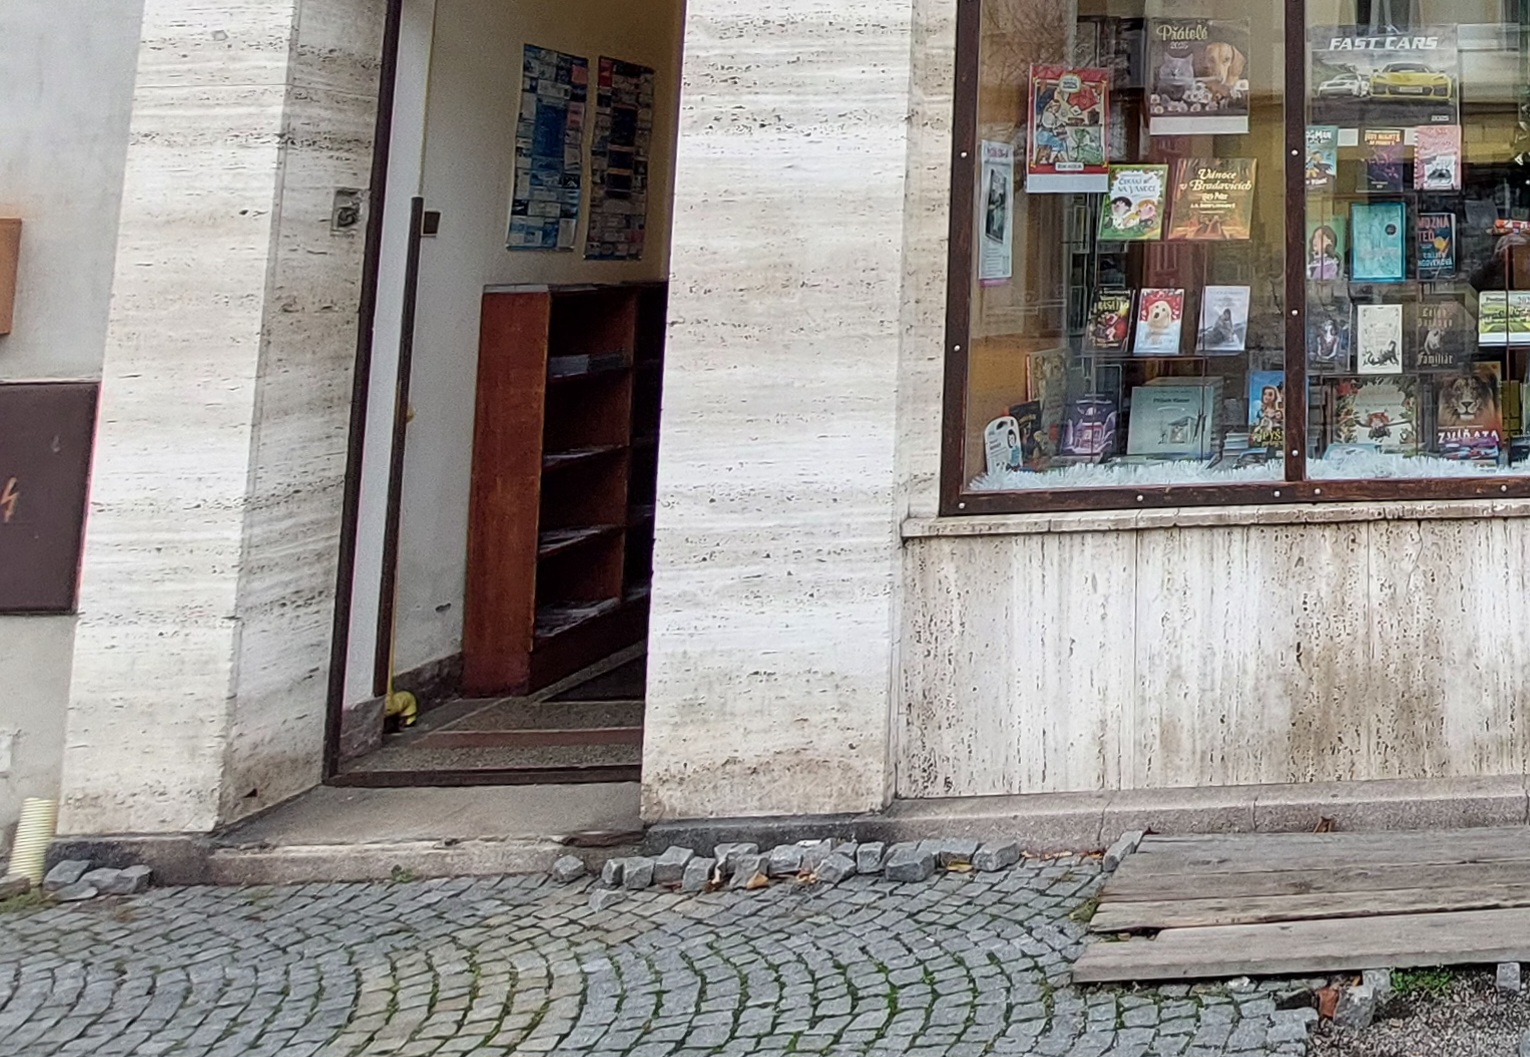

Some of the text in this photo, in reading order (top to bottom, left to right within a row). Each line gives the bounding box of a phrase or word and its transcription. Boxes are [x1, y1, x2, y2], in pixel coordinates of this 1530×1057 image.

[1156, 23, 1208, 41] Přátelé
[1329, 36, 1438, 50] FAST CARS
